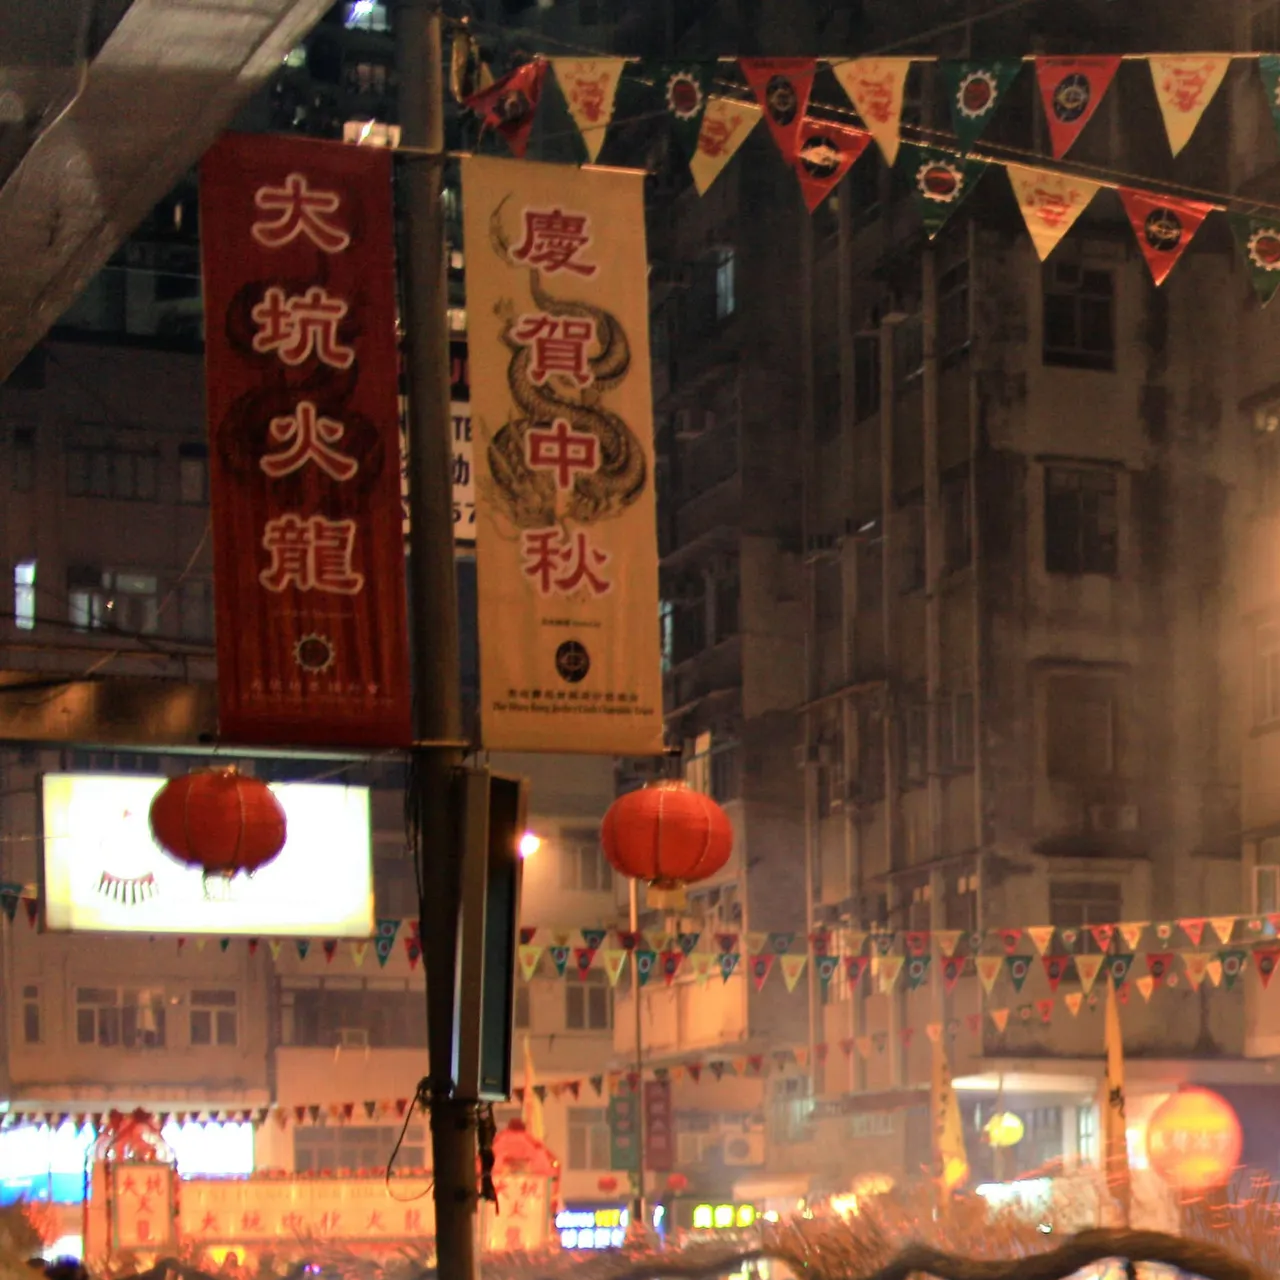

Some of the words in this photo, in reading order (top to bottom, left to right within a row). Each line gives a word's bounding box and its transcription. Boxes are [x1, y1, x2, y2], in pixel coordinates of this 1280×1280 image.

[252, 174, 364, 596] 大坑火龍
[511, 207, 613, 599] 慶賀中秋
